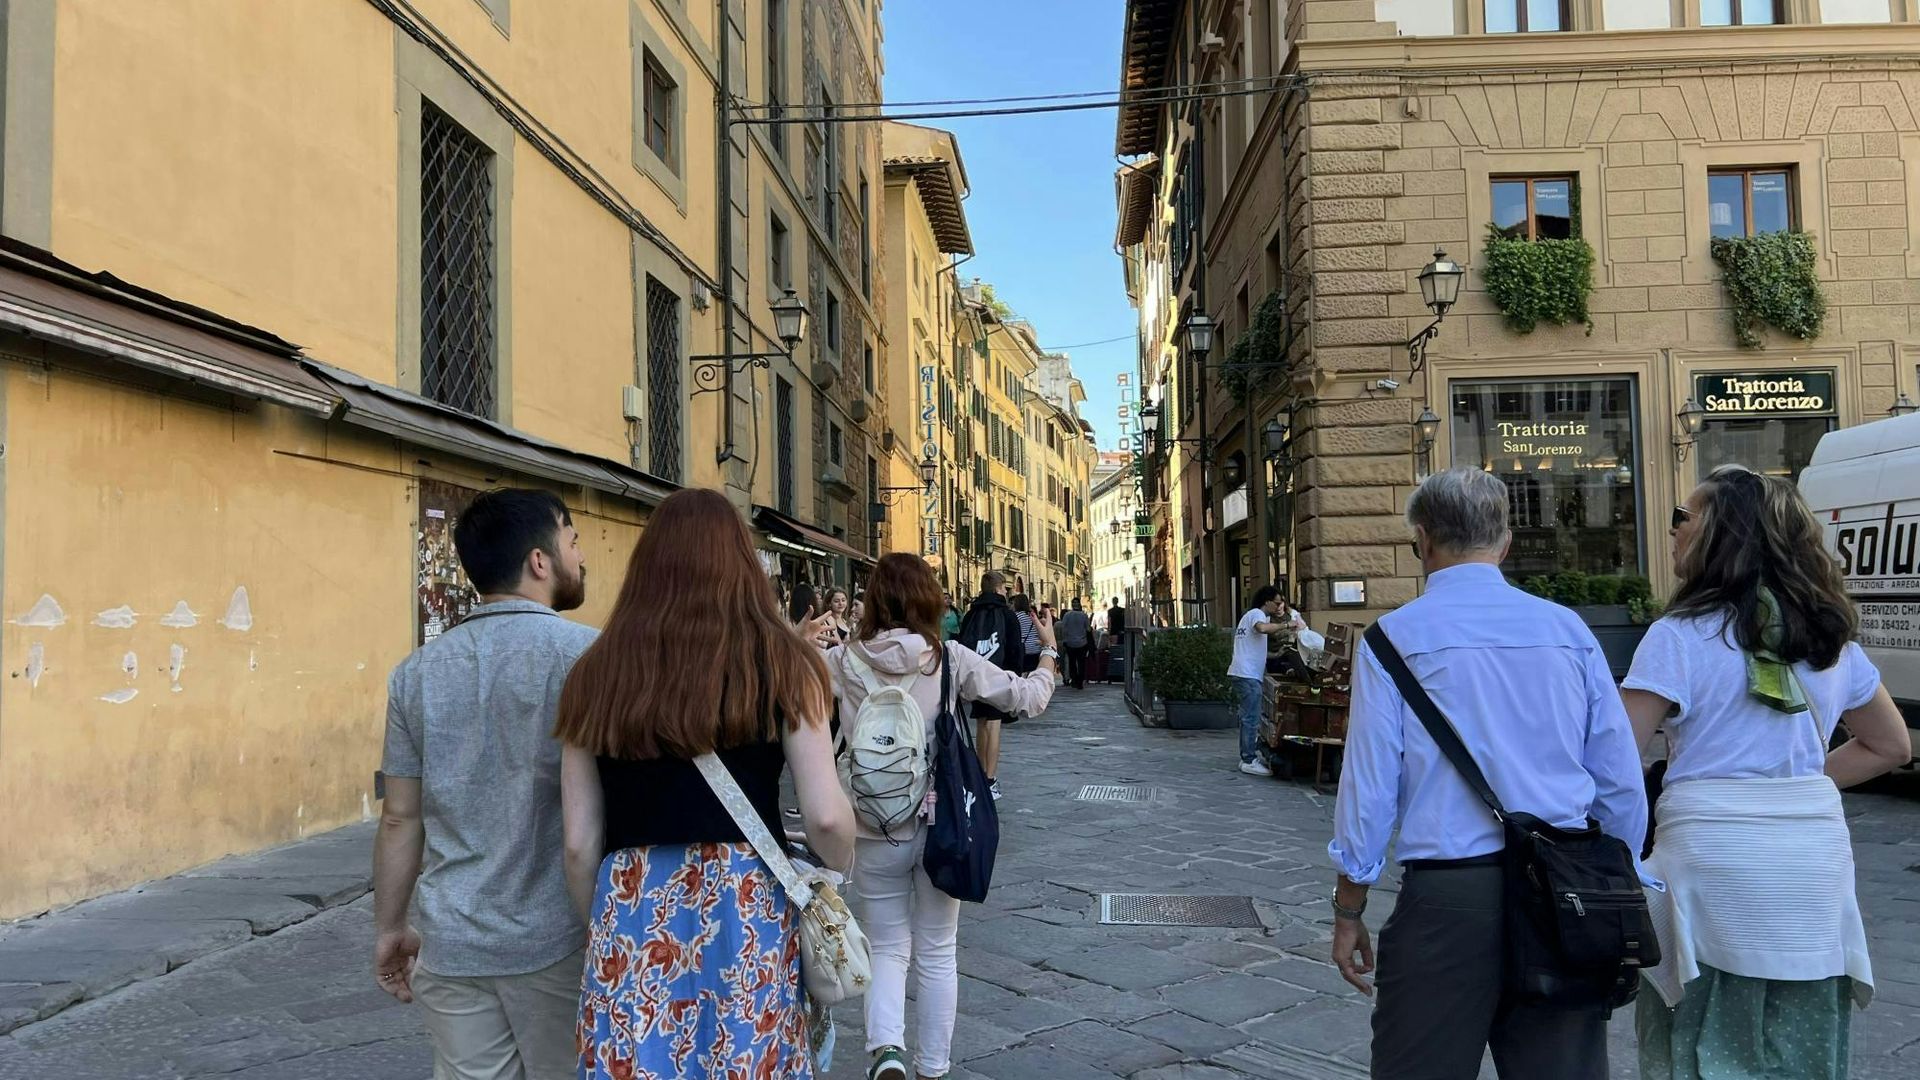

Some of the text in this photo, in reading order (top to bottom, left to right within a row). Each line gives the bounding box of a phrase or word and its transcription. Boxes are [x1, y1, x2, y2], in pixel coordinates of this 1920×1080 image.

[1722, 377, 1805, 394] Trattoria
[1705, 394, 1824, 411] San Lorenzo
[1497, 420, 1587, 437] Trattoria
[1503, 440, 1582, 456] San Lorenzo
[1837, 503, 1920, 576] solu
[1861, 604, 1899, 616] SERVIZIO
[1861, 618, 1879, 629] 0583
[1881, 619, 1910, 631] 264322
[1860, 635, 1920, 647] soluzioniar
